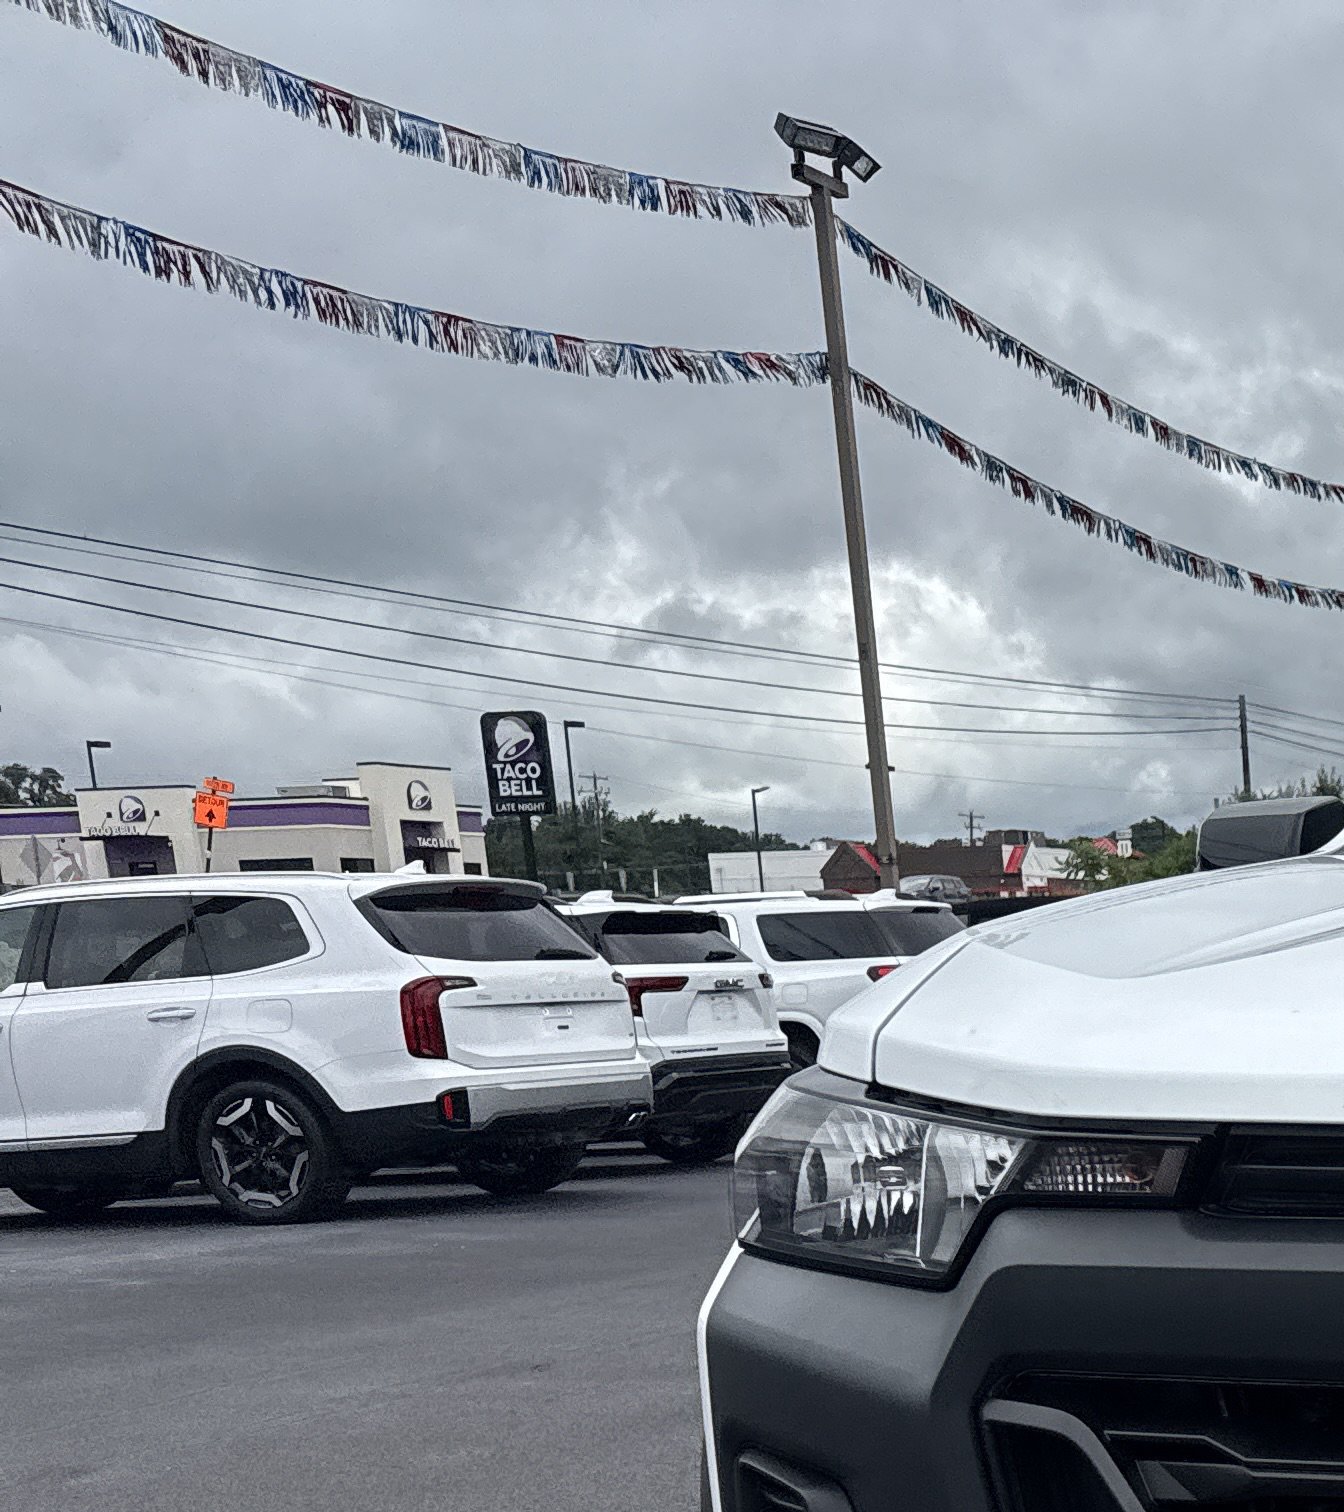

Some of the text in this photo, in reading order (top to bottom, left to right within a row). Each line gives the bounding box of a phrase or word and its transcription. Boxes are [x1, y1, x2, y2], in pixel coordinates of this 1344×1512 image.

[492, 762, 541, 779] TACO
[498, 780, 543, 796] BELL
[198, 795, 225, 808] DETOUR
[495, 802, 546, 812] LATE NIGHT
[417, 836, 439, 848] TACO
